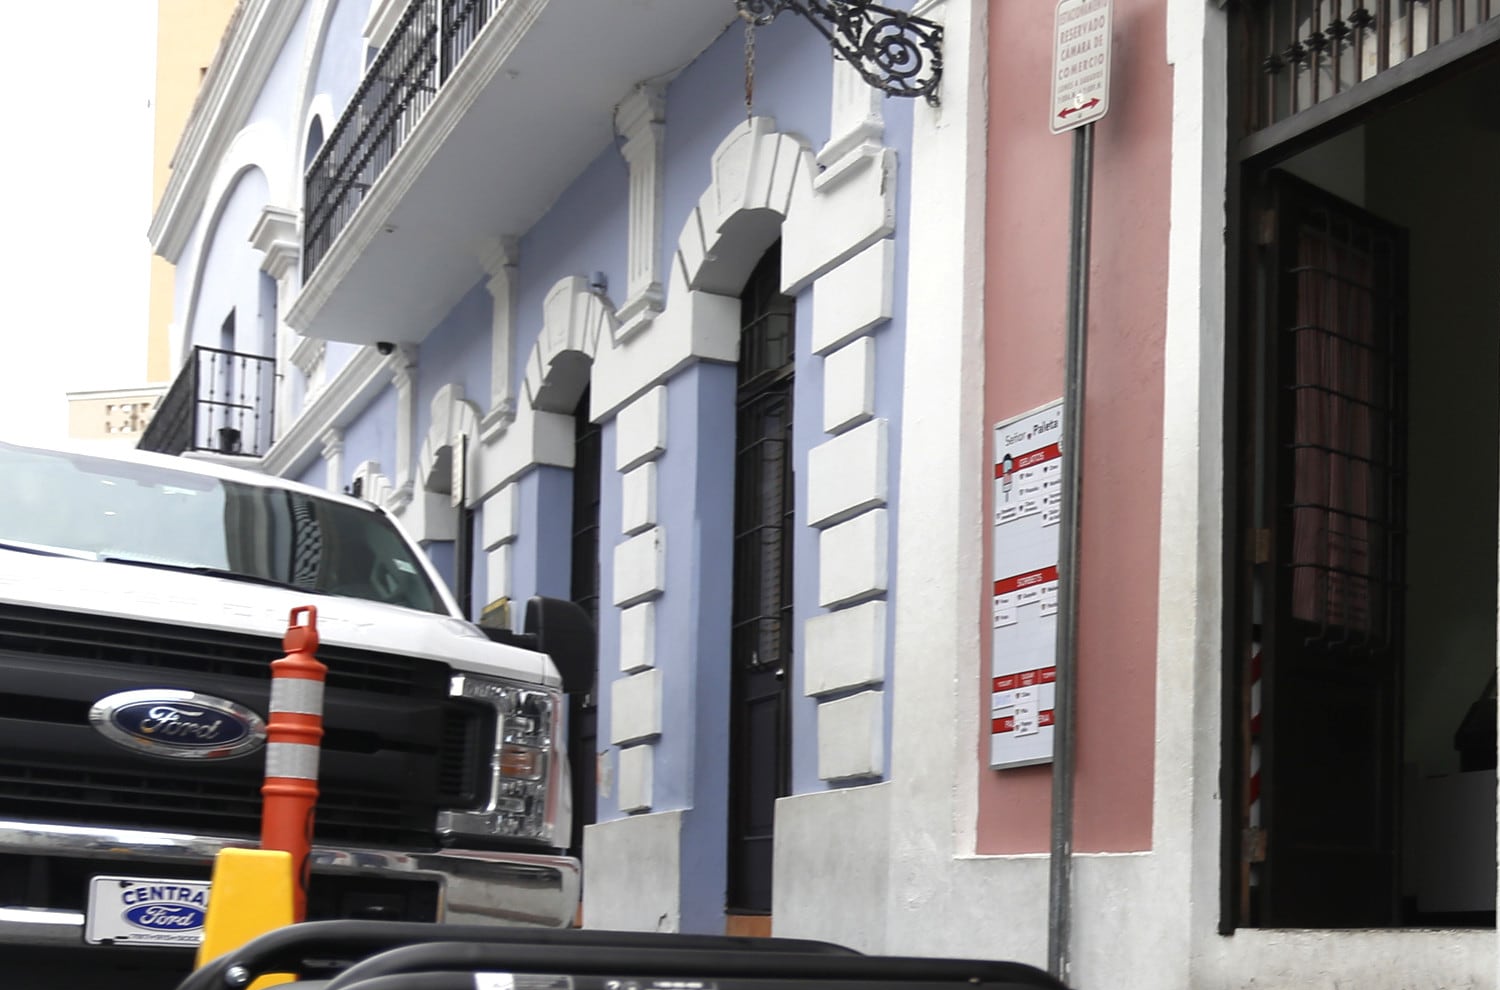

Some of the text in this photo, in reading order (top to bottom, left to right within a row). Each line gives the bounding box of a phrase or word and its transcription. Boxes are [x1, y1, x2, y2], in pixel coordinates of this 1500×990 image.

[1061, 15, 1104, 43] RESERVADO
[1094, 35, 1103, 48] DE
[1059, 53, 1104, 80] COMERCIO
[1033, 420, 1058, 436] Paleta
[140, 706, 222, 739] Ford
[122, 886, 208, 907] CENTRA
[140, 905, 196, 926] Ford
